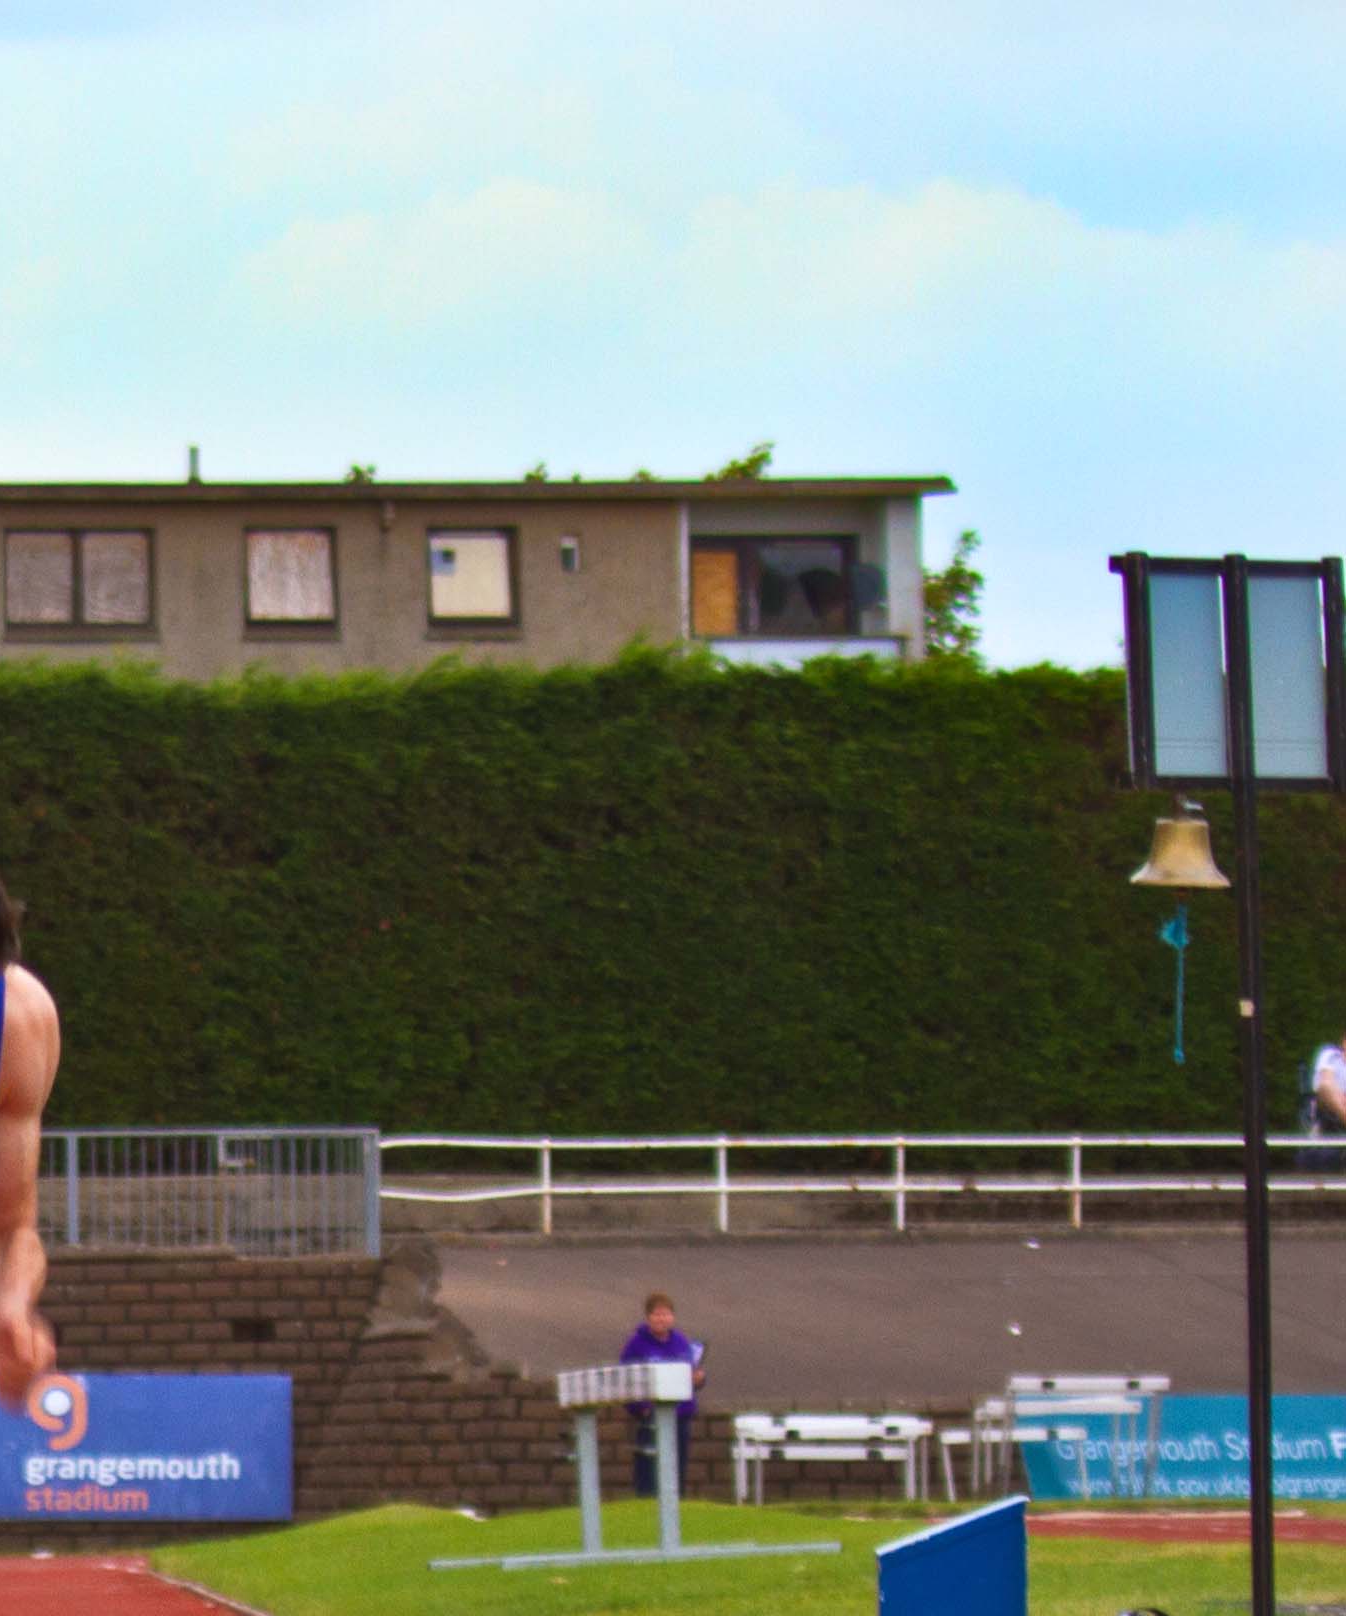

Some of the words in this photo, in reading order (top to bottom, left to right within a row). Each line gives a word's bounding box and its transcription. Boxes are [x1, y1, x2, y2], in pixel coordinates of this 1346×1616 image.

[1224, 1432, 1328, 1461] Stium
[25, 1452, 241, 1486] grangemouth
[24, 1485, 150, 1513] stadium
